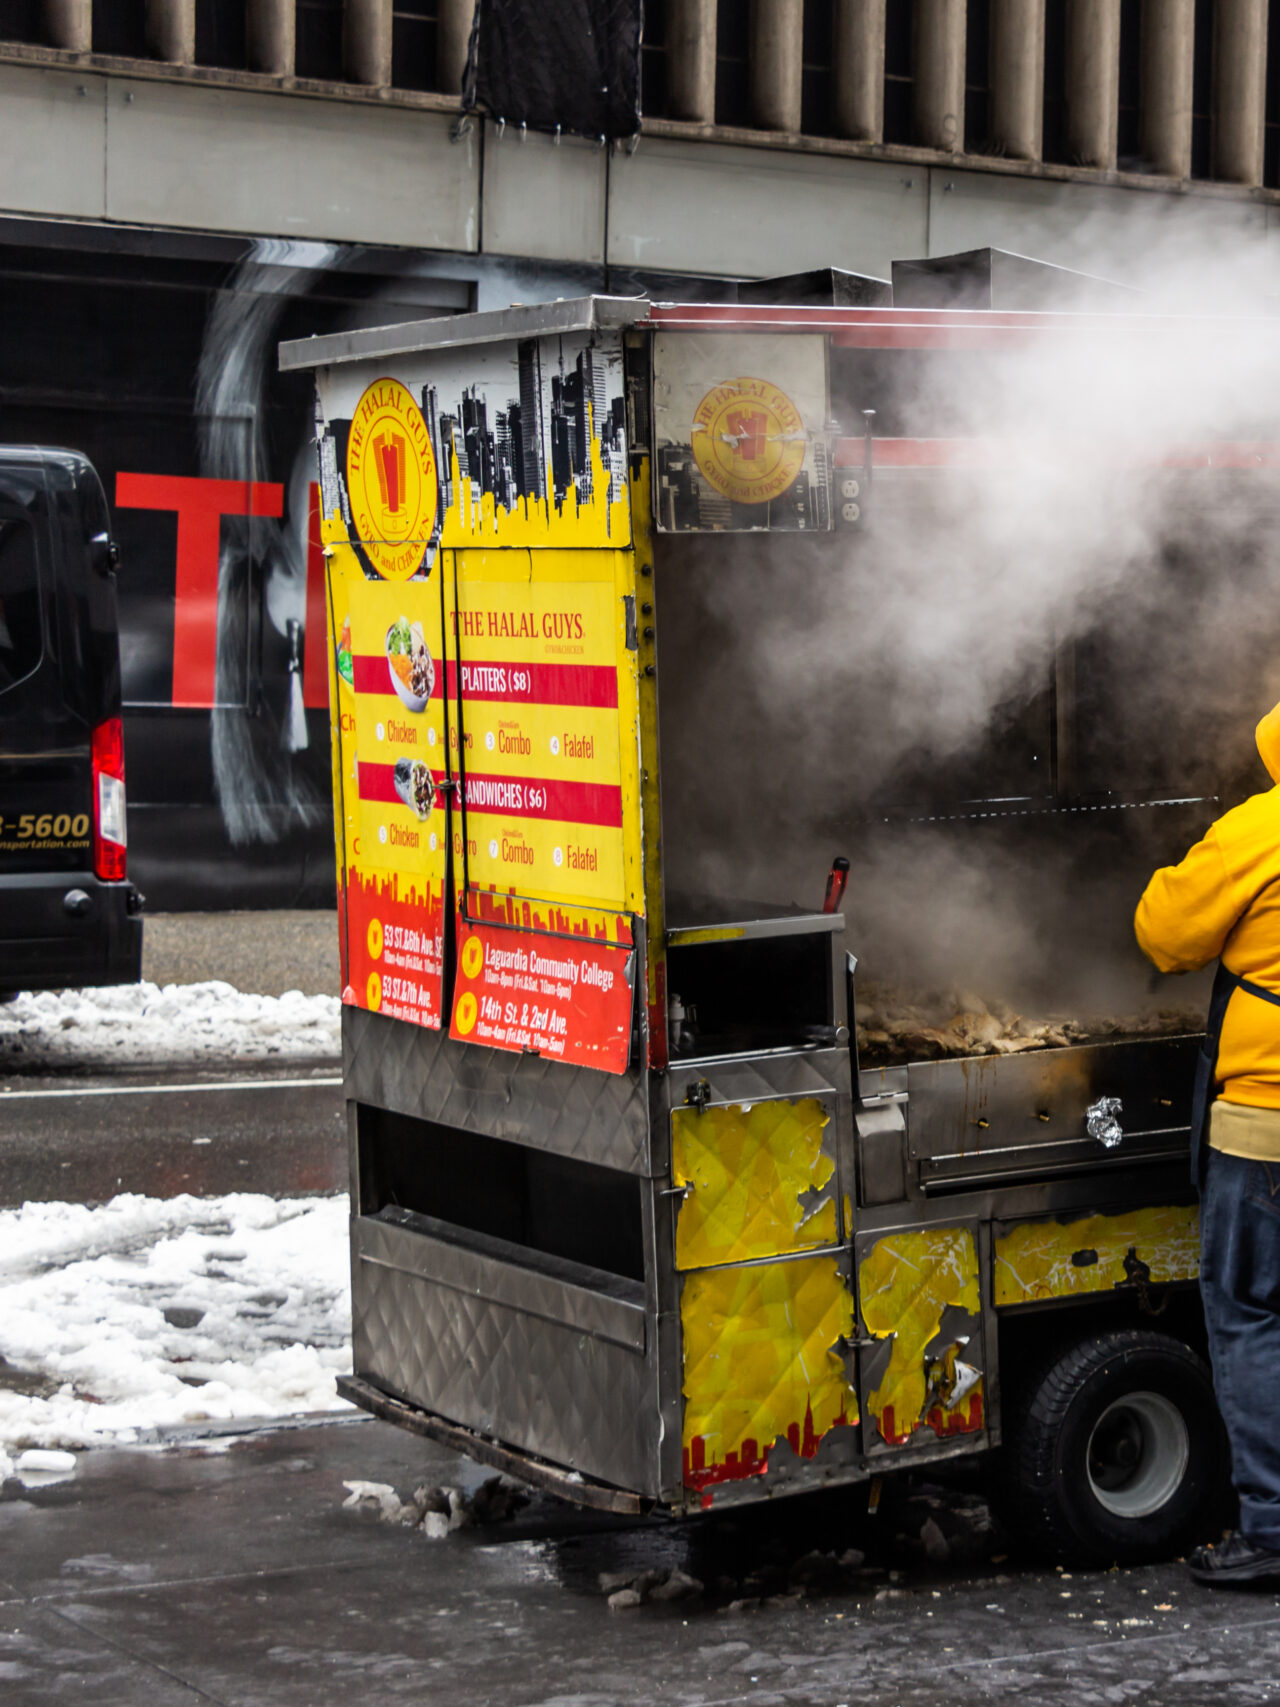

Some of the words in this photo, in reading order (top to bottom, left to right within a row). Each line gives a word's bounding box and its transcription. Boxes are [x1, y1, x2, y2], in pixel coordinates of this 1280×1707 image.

[696, 401, 716, 437] THE
[716, 382, 768, 402] HALAL
[771, 393, 799, 435] GUYS
[351, 421, 364, 477] THE
[361, 386, 403, 424] HALAL
[406, 406, 433, 475] GUYS
[704, 459, 729, 490] GYRO
[751, 461, 796, 497] CHICKEN
[359, 513, 380, 560] GYRO
[381, 556, 396, 572] and
[397, 513, 430, 573] CHICKEN
[115, 471, 327, 709] T
[450, 611, 484, 637] THE
[488, 612, 539, 638] HALAL
[543, 613, 584, 639] GUYS
[461, 666, 507, 693] PLATTERS
[388, 720, 417, 744] Chicken
[499, 729, 531, 756] Combo
[564, 733, 594, 759] Falafel
[456, 780, 522, 809] SANDWICHES
[390, 824, 419, 848] Chicken
[502, 838, 534, 865] Combo
[567, 845, 598, 872] Falafel
[384, 924, 394, 947] 53
[485, 942, 528, 971] Laguardia
[530, 950, 579, 985] Community
[581, 960, 614, 992] College
[382, 975, 392, 998] 53
[418, 984, 432, 1008] Ave.
[481, 995, 502, 1021] 14th
[504, 1002, 518, 1025] St.
[521, 1003, 529, 1027] &
[530, 1005, 549, 1030] 2nd
[548, 1009, 568, 1035] Ave.
